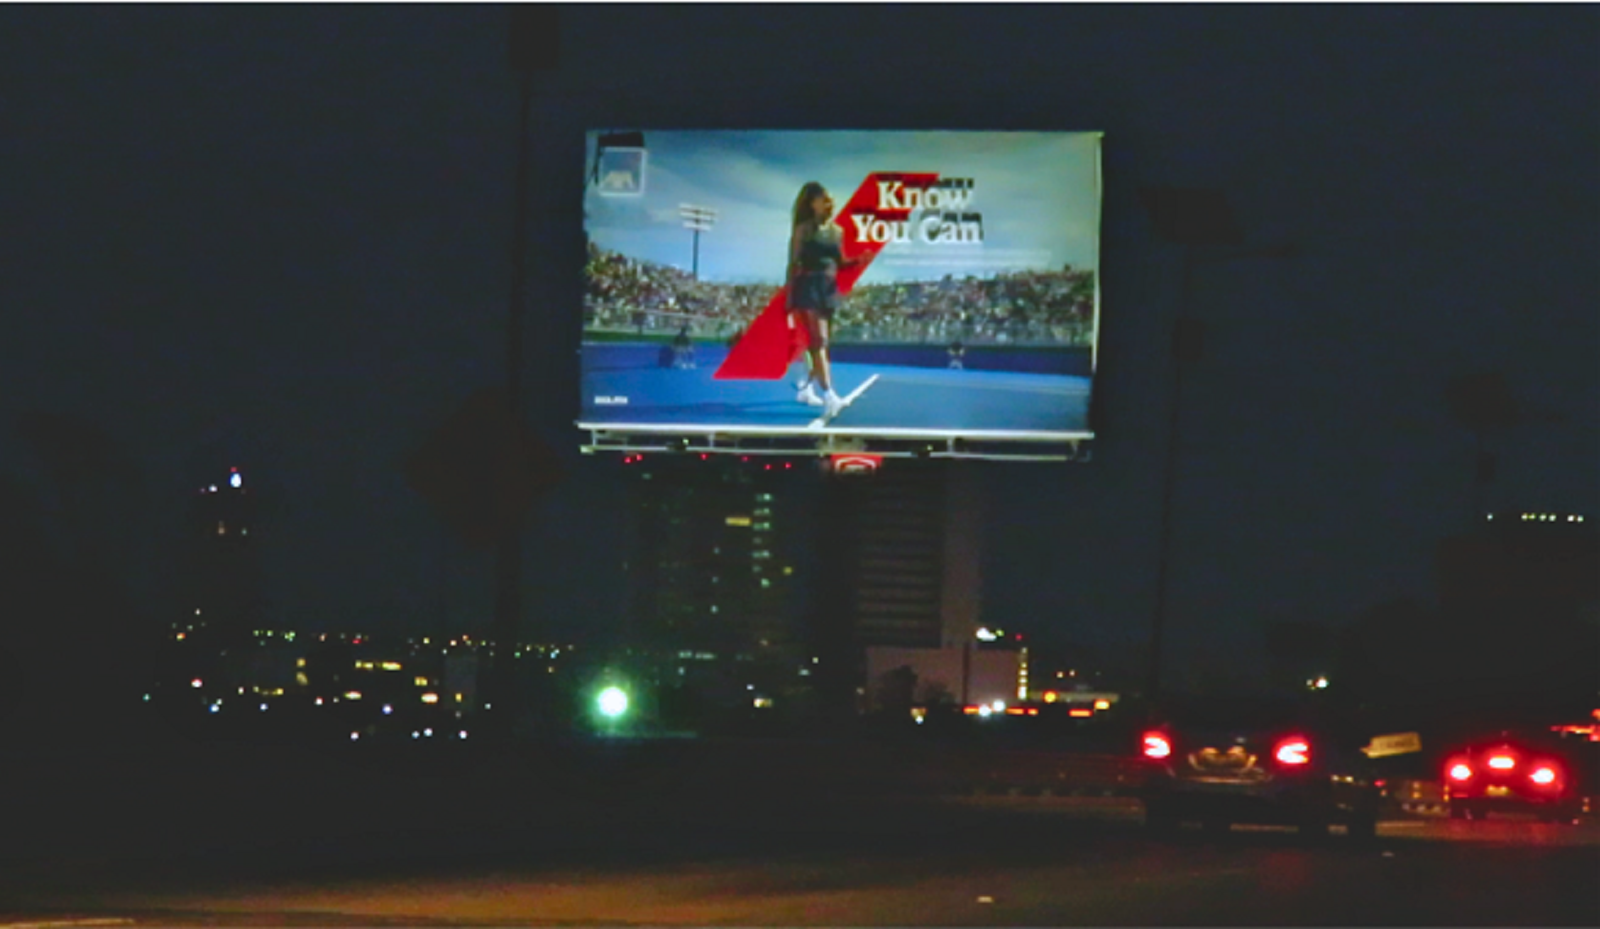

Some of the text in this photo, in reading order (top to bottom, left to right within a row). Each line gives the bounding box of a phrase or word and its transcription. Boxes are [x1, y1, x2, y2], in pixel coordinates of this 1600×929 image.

[877, 180, 973, 210] Know
[851, 214, 983, 244] You Can
